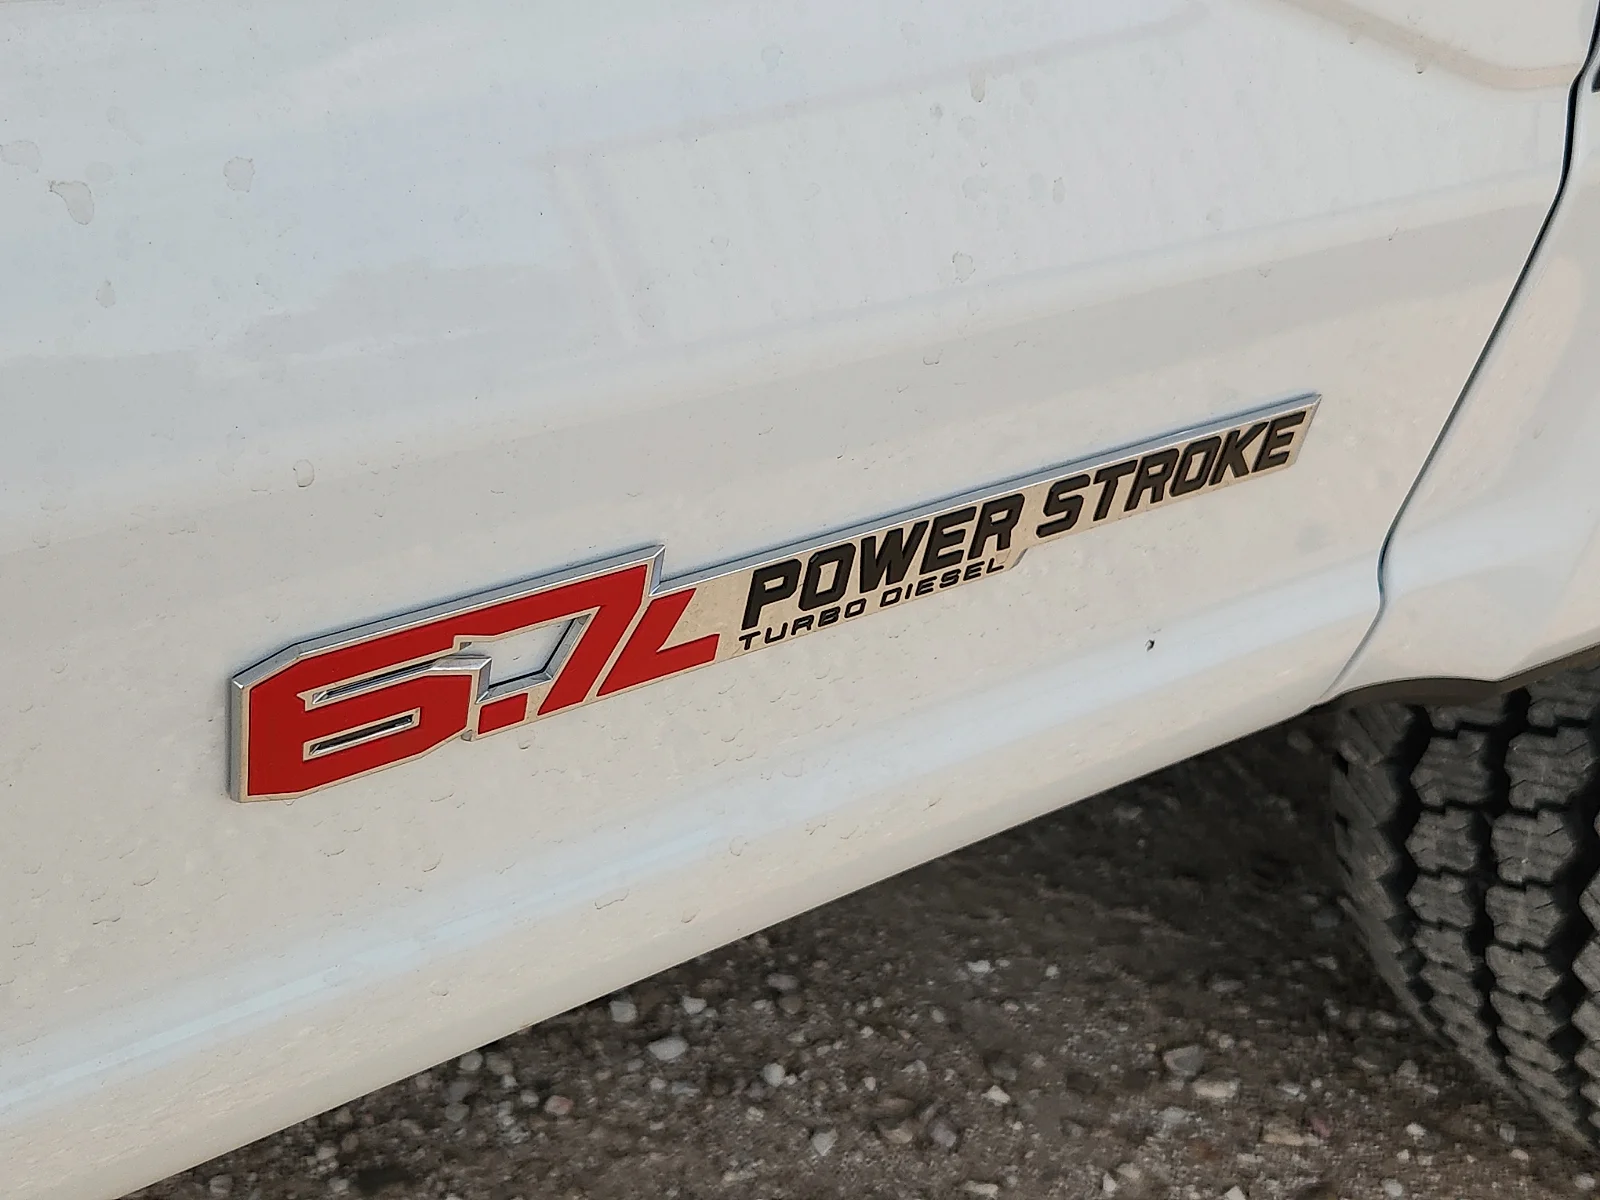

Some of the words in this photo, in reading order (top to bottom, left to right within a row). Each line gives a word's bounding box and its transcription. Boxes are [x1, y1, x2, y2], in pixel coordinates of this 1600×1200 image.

[246, 563, 721, 797] 6.7L
[740, 492, 1026, 631] POWER
[1035, 410, 1307, 539] STROKE
[738, 597, 867, 651] TURBO
[879, 556, 1005, 608] DIESEL
